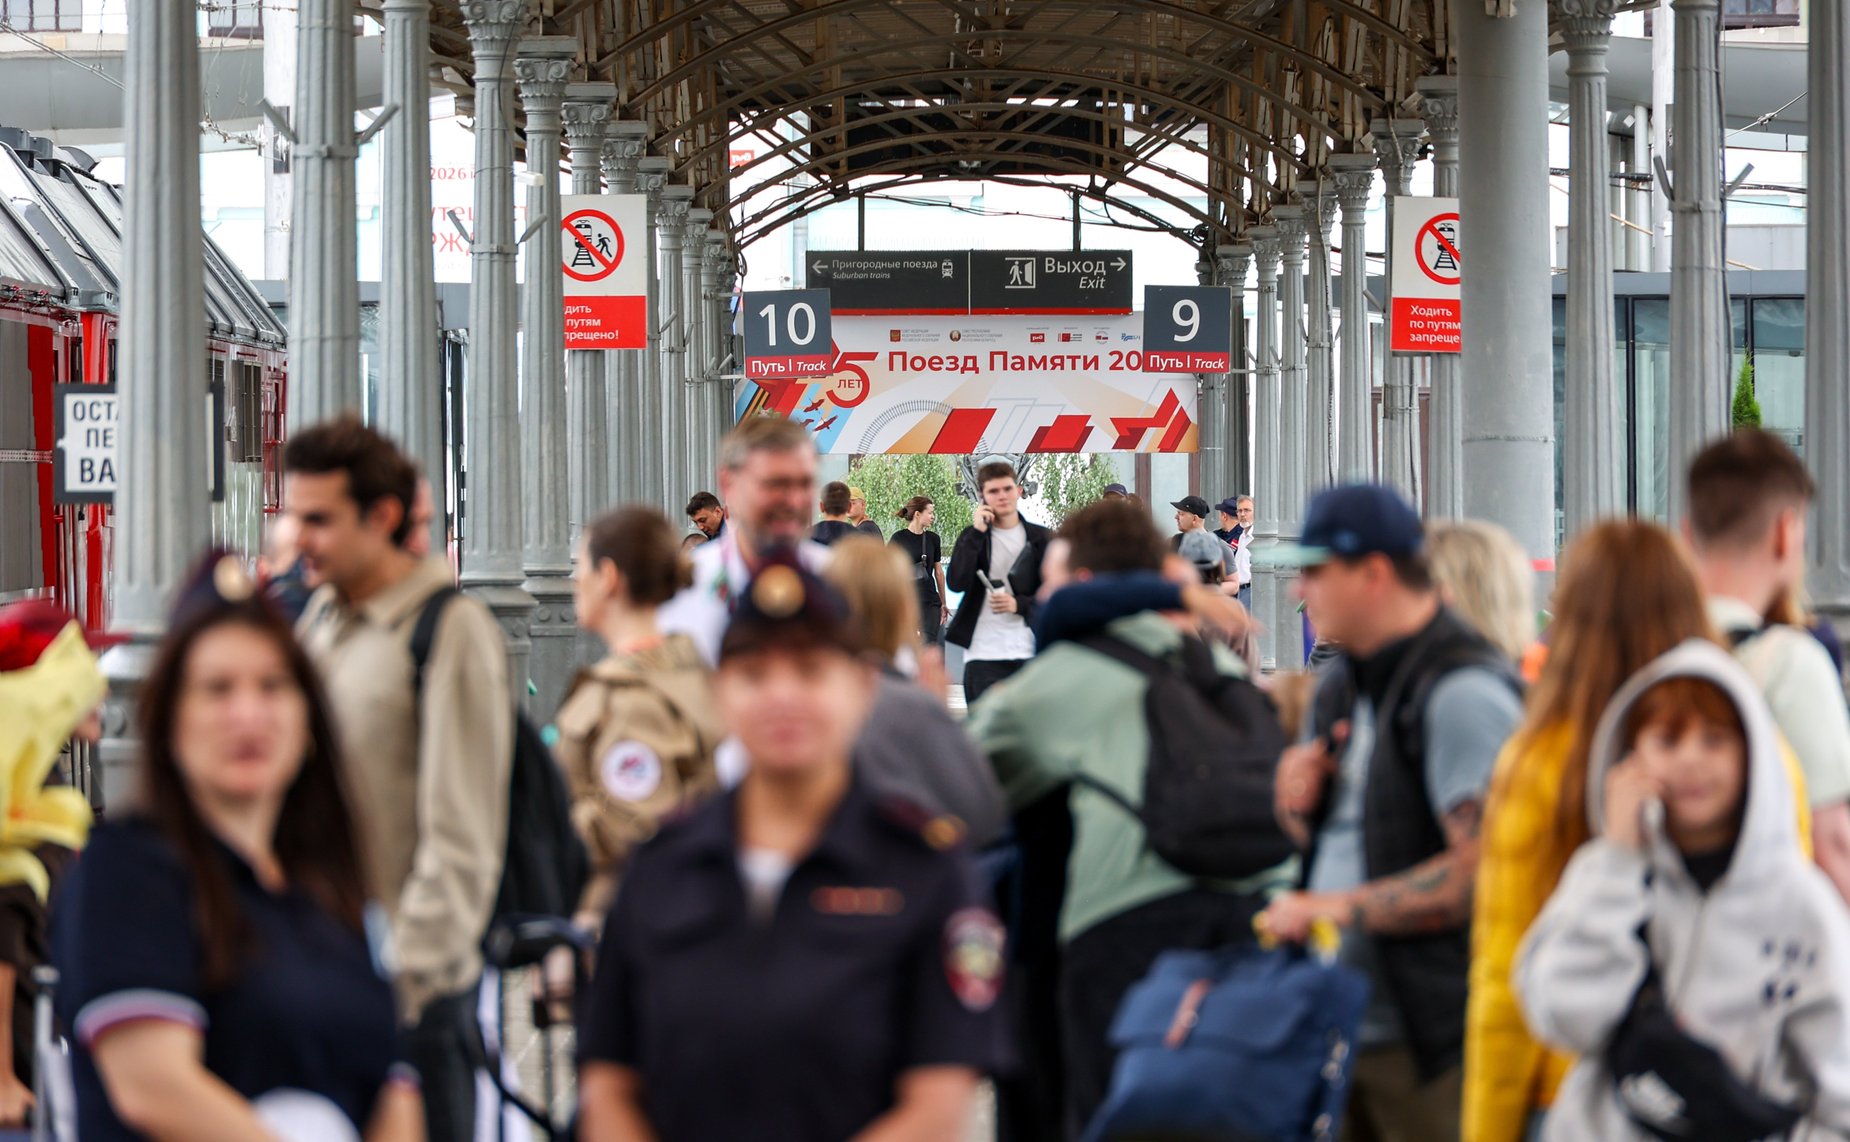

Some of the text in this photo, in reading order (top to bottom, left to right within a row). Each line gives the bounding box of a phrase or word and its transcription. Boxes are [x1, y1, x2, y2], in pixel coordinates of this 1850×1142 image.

[832, 259, 938, 270] Пригородные поезда
[1045, 257, 1107, 276] Выход
[1079, 277, 1106, 289] Exit
[1410, 304, 1453, 317] Ходить
[566, 318, 602, 329] путям
[759, 302, 816, 346] 10
[1172, 299, 1200, 342] 9
[1409, 320, 1461, 332] по путям
[1409, 333, 1461, 344] запреще
[751, 360, 827, 376] Путь Track
[888, 351, 980, 374] Поезд
[989, 351, 1099, 371] Памяти
[1149, 355, 1225, 371] Путь Track
[837, 379, 863, 389] ЛЕТ
[73, 401, 119, 421] ОСТ
